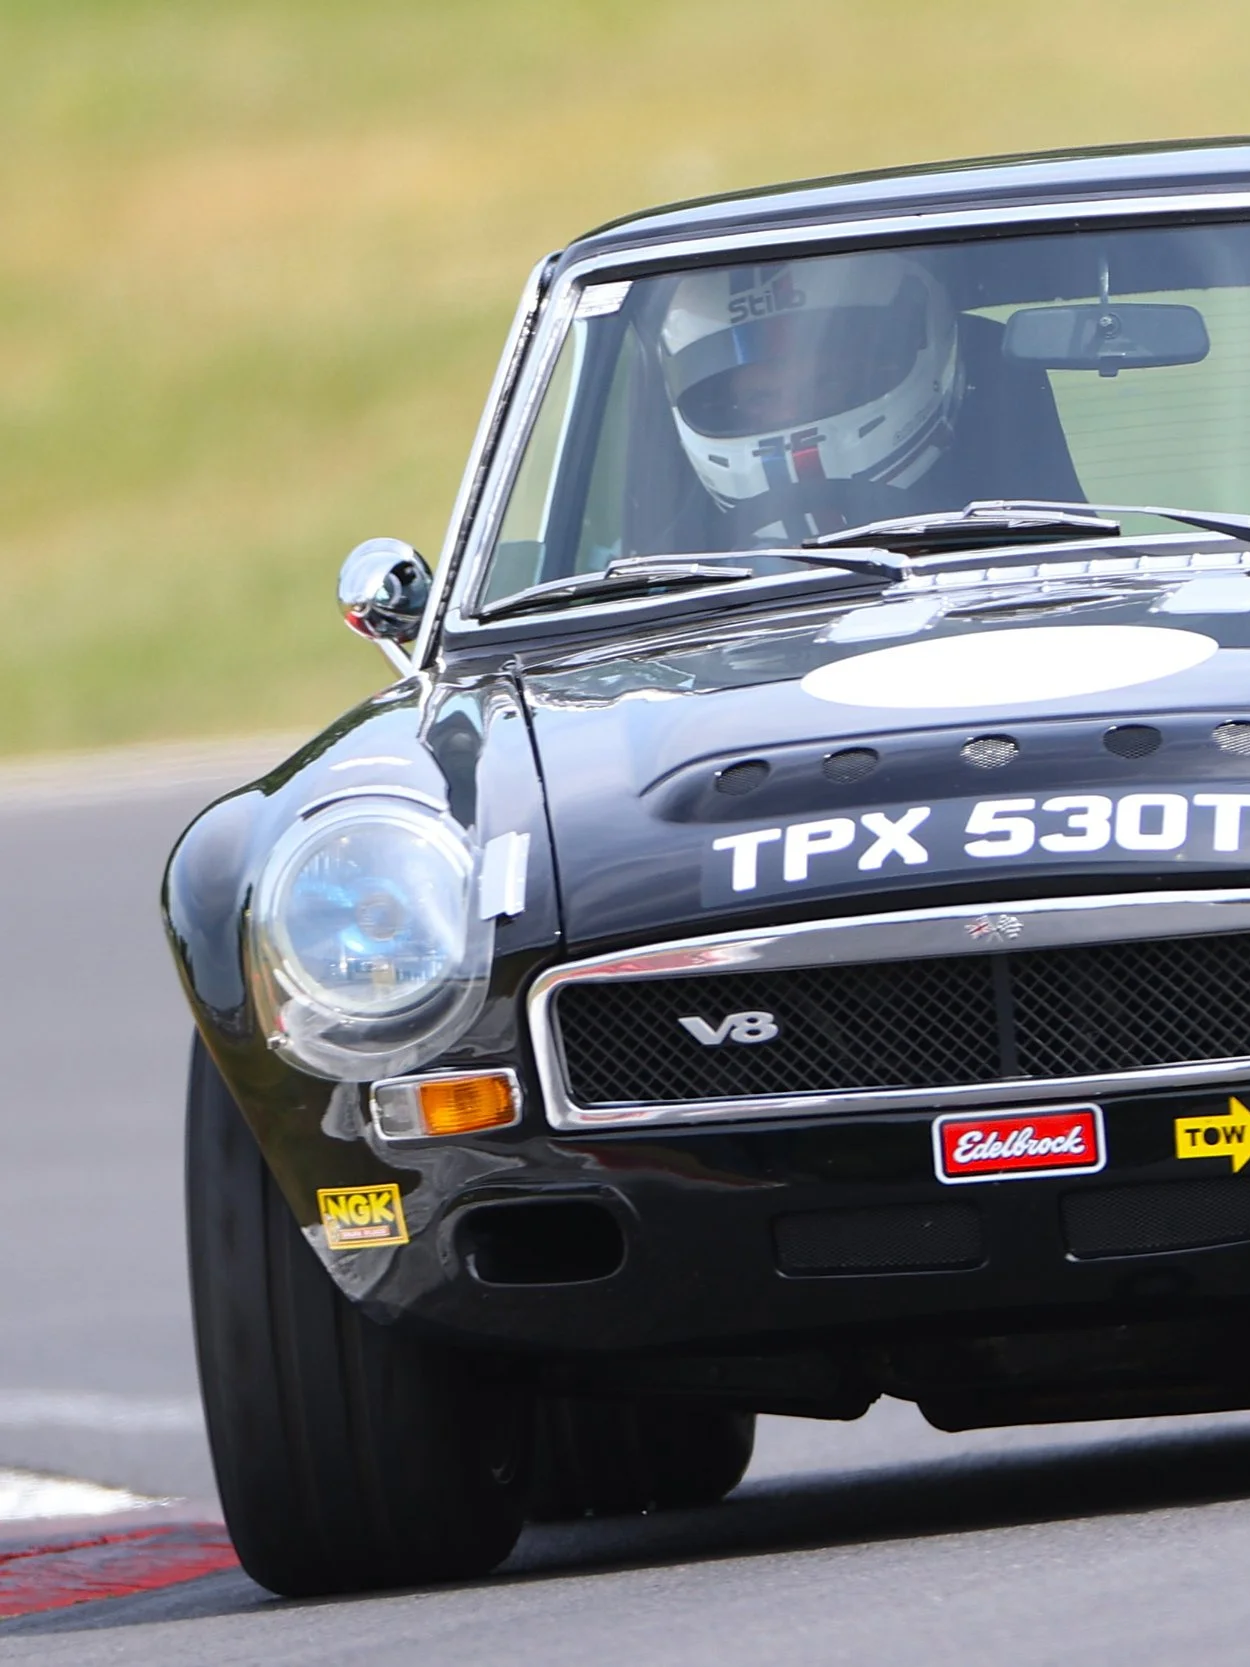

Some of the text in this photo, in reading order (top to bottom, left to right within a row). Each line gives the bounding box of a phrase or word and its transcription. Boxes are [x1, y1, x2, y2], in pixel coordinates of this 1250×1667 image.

[712, 806, 931, 892] TPX
[678, 1011, 779, 1045] V8
[953, 1125, 1086, 1163] Edelbrock
[1184, 1125, 1246, 1147] TOW
[326, 1191, 395, 1226] NGK
